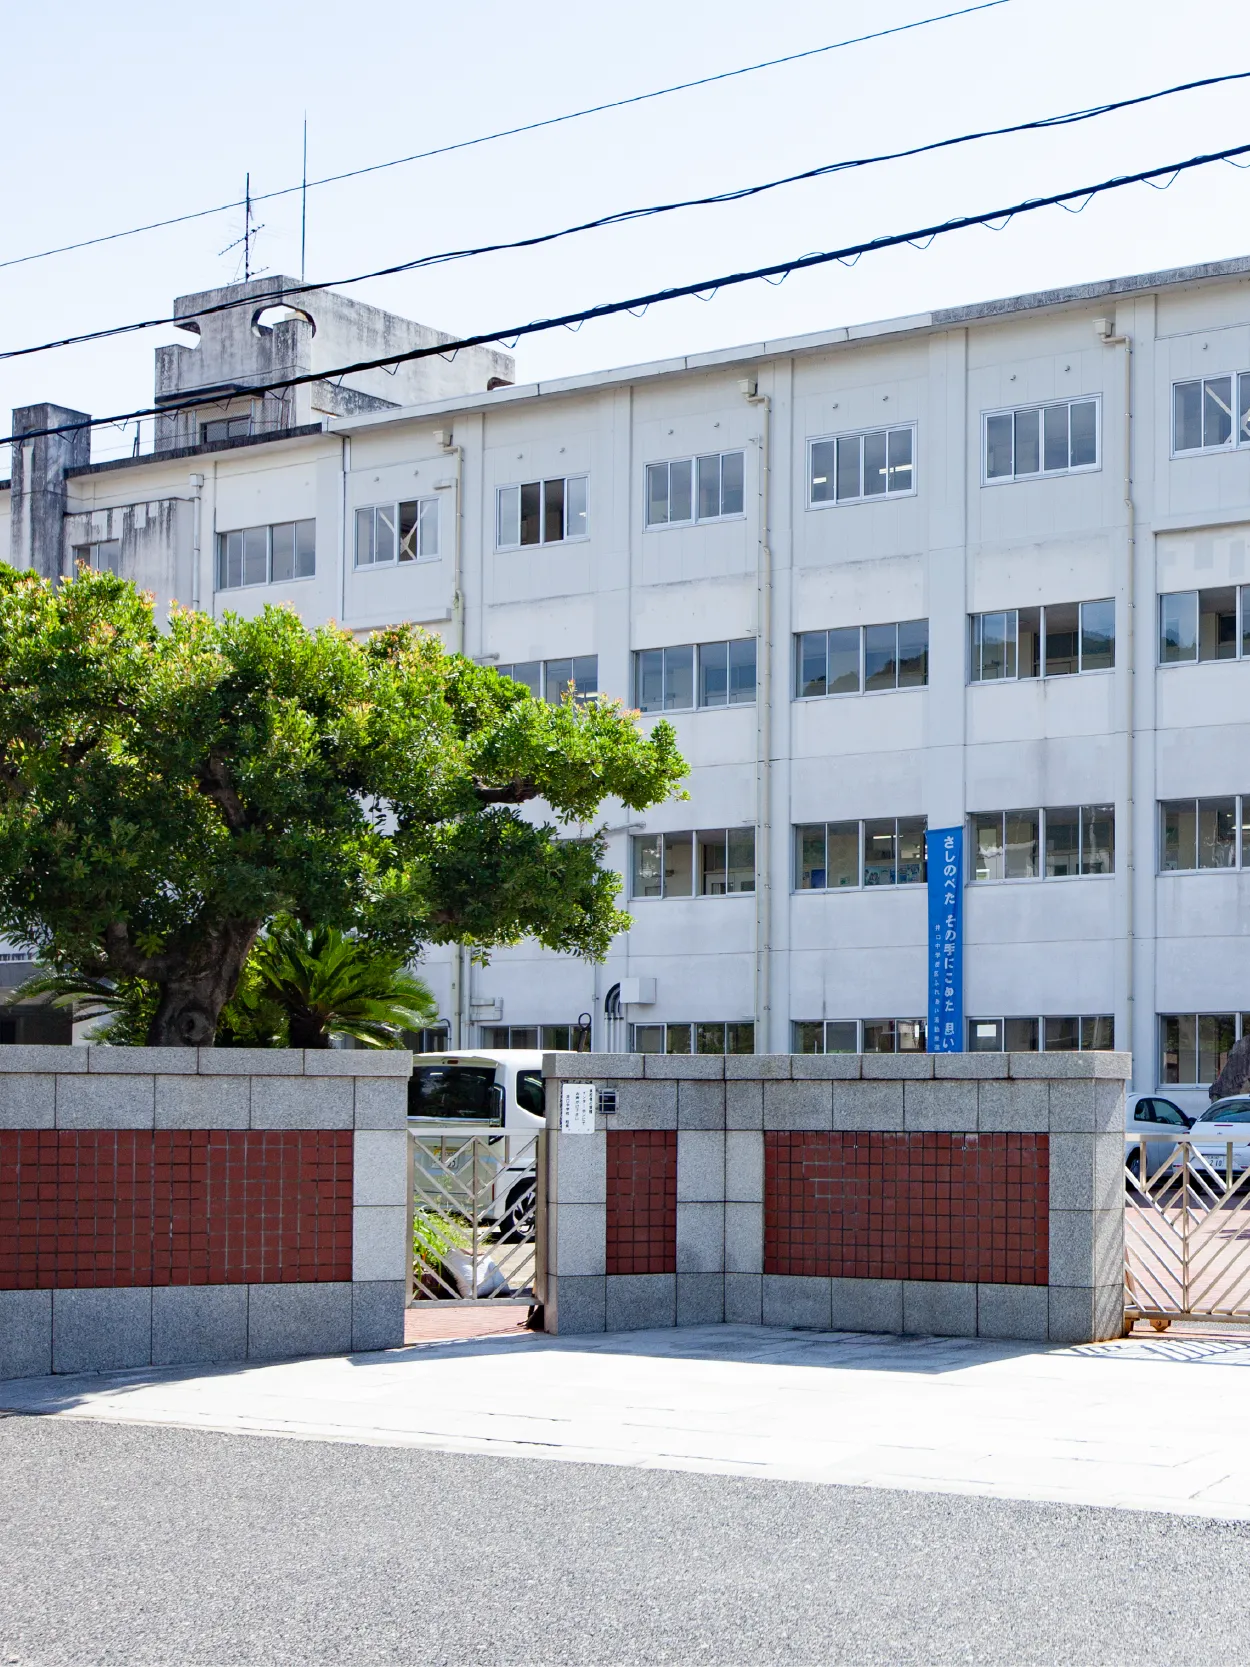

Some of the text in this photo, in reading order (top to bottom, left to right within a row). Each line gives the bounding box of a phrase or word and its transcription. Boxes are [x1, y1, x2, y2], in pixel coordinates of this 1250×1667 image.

[942, 835, 957, 1052] さしのべた その手にこめた 思い
